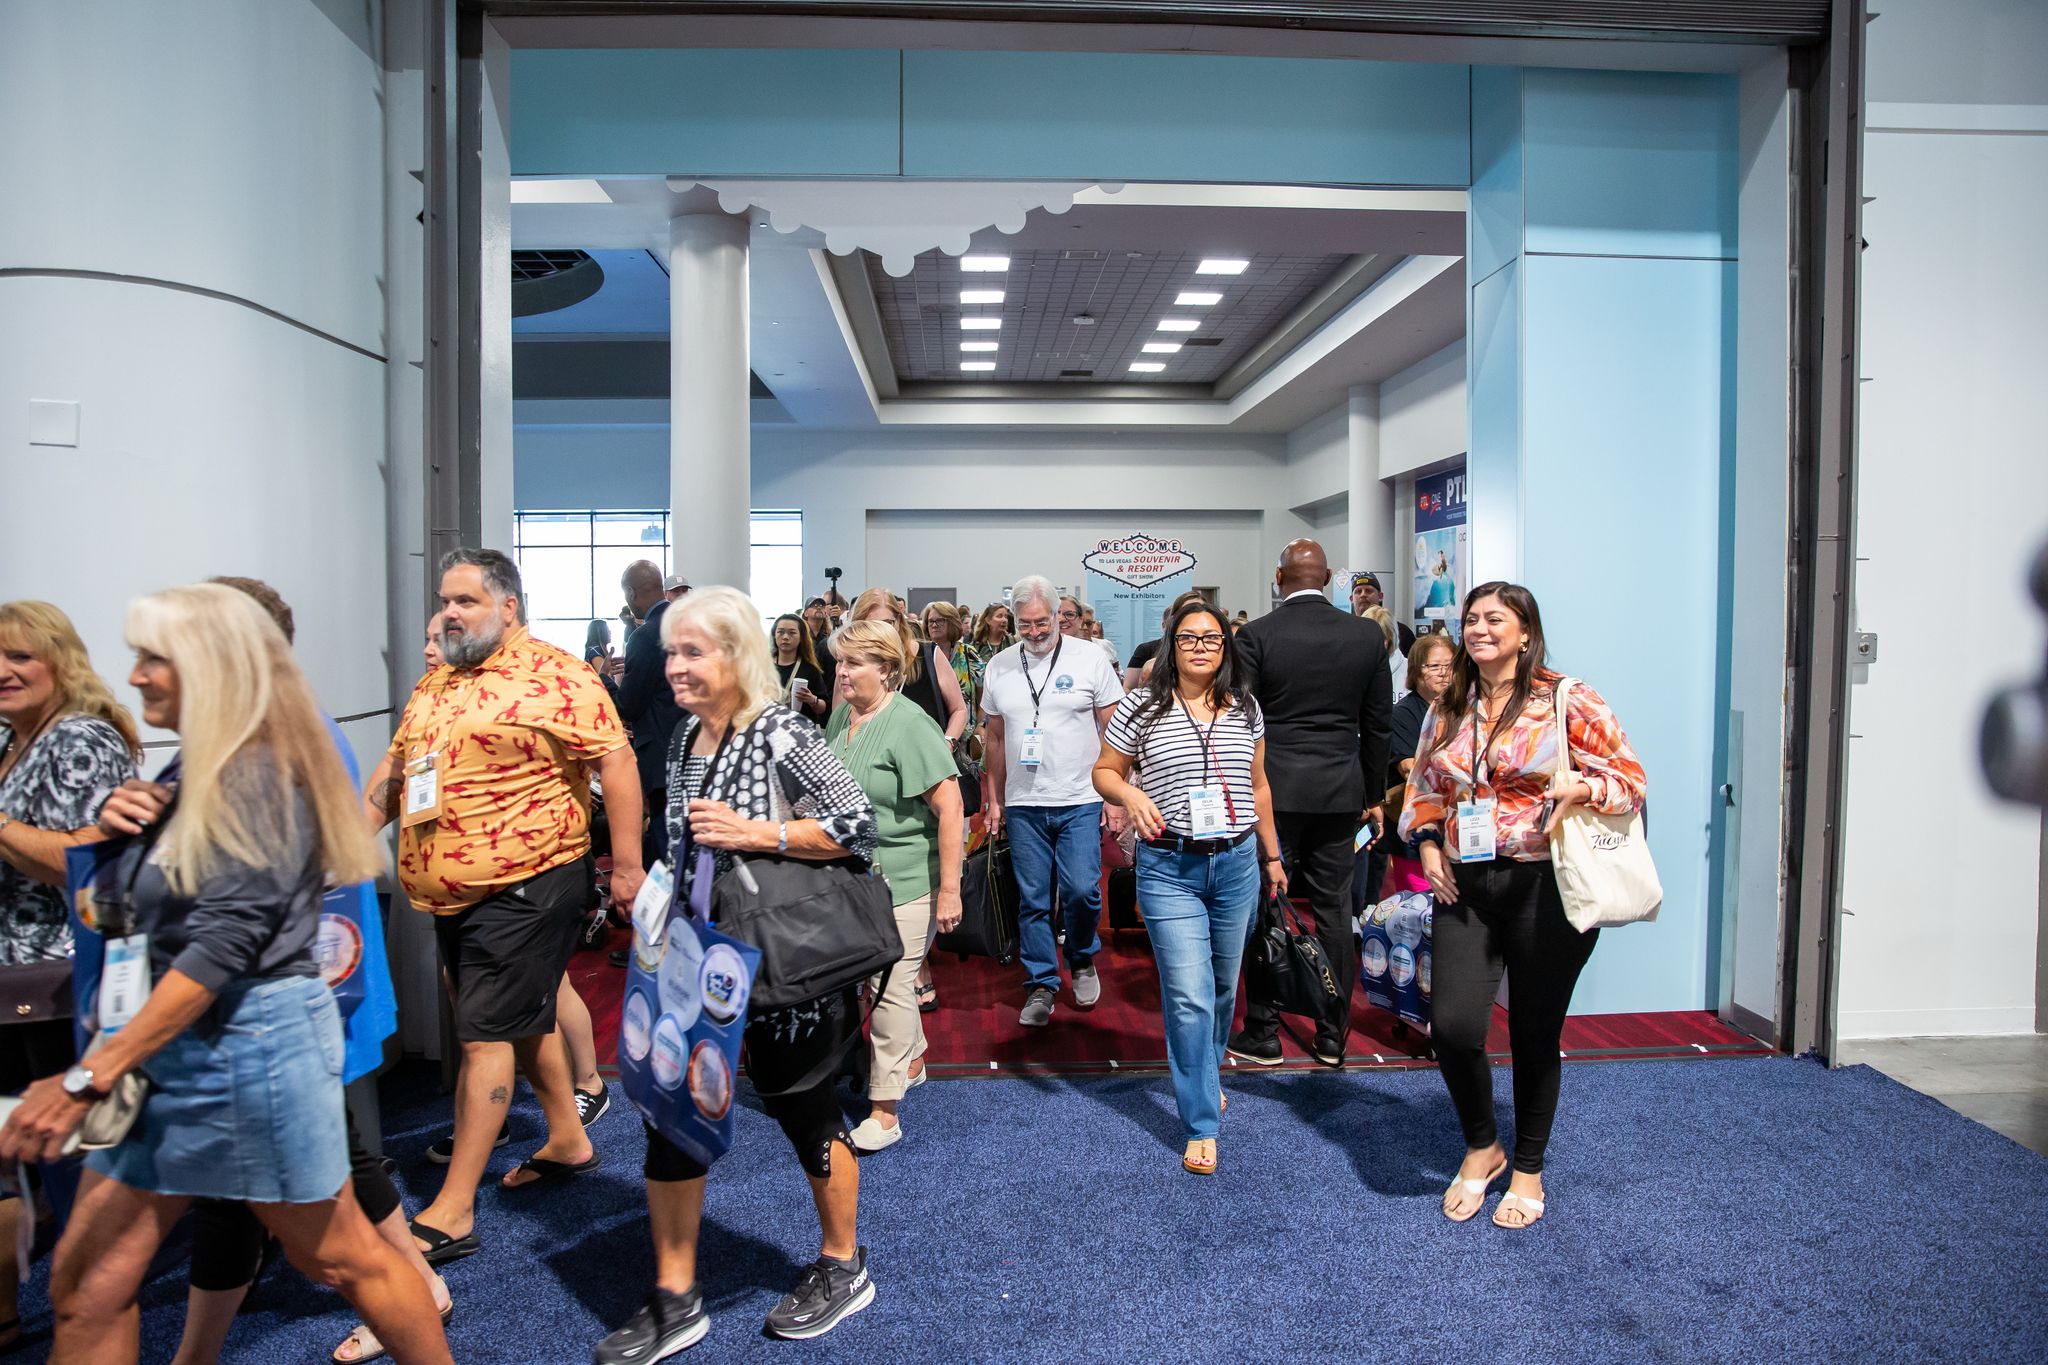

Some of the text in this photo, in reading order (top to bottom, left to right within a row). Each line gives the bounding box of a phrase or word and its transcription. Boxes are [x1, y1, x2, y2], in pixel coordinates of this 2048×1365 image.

[1100, 542, 1178, 551] WELCOME
[1116, 565, 1165, 573] & RESORT
